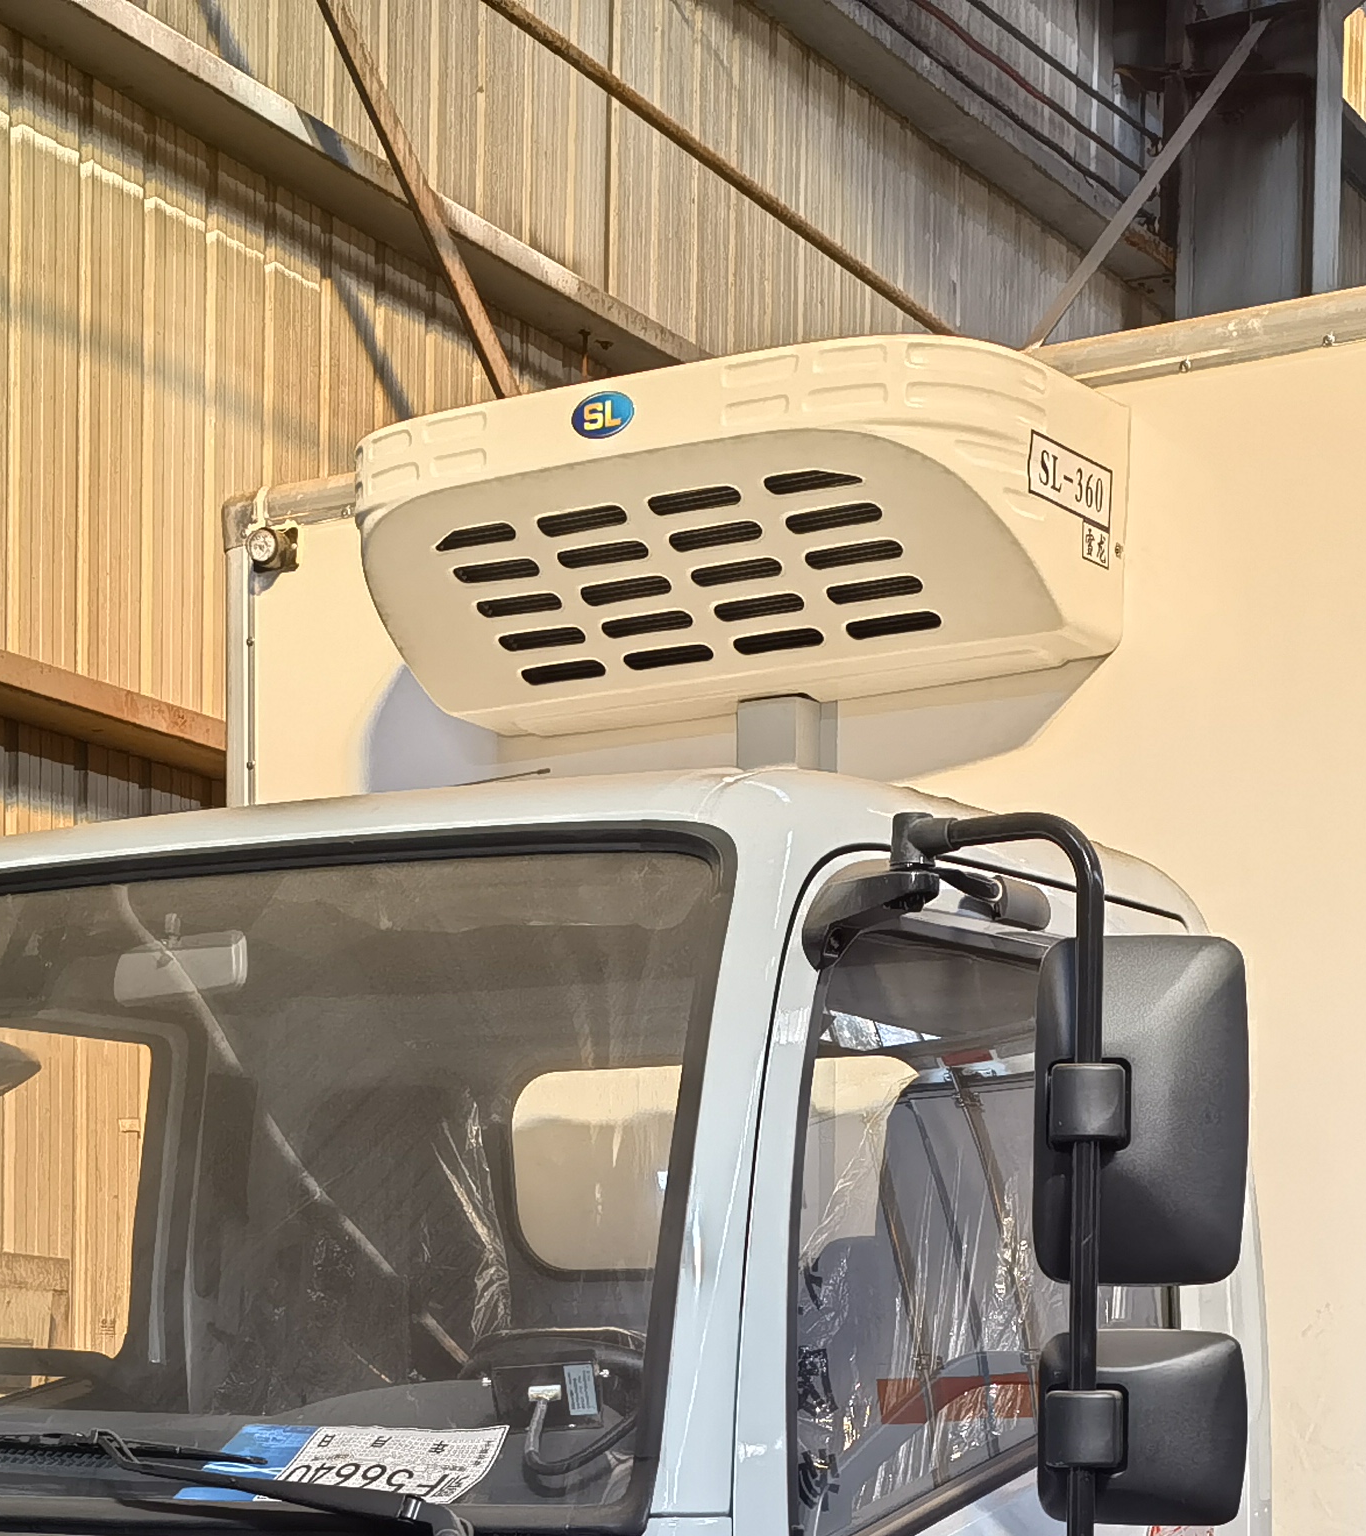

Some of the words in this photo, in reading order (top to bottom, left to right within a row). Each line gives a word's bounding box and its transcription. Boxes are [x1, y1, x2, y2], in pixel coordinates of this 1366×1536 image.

[584, 400, 622, 431] SL
[1038, 449, 1103, 513] SL-360
[320, 1433, 336, 1448] 日
[373, 1436, 392, 1449] 月
[430, 1441, 449, 1455] 年
